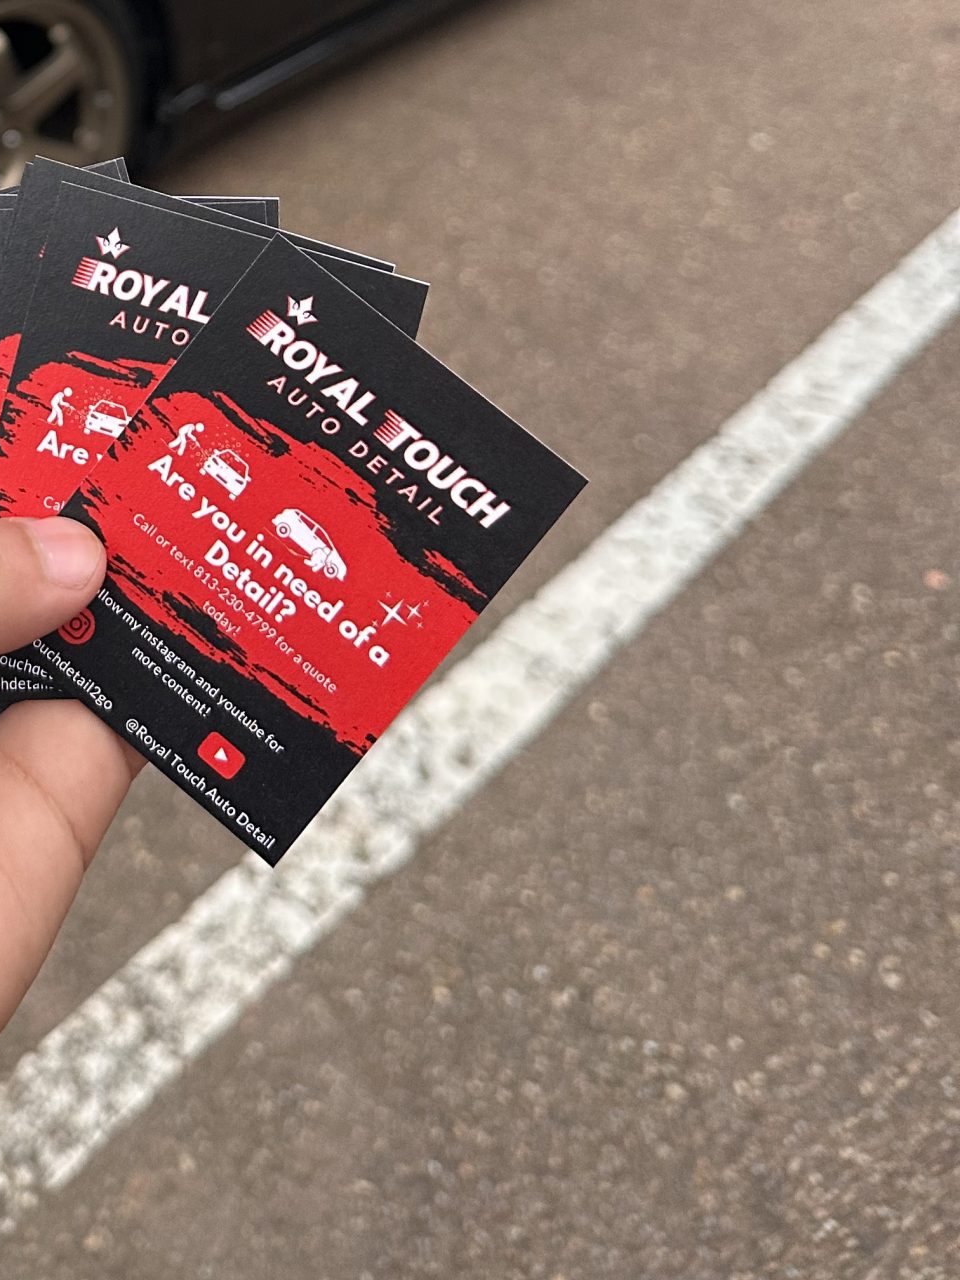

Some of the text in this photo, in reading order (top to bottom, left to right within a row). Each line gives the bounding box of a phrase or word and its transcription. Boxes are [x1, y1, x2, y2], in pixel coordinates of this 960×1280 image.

[77, 257, 212, 324] ROYAL
[109, 310, 190, 347] AUTO
[36, 429, 89, 465] Are
[250, 314, 511, 529] ROYAL TOUCH
[266, 375, 444, 526] AUTO DETAIL
[147, 454, 390, 667] Are you in need of a
[203, 539, 297, 623] Detail?
[133, 513, 338, 694] Call or text 813-230-4799 for a quote
[202, 600, 242, 637] today!
[33, 638, 114, 711] ouchdetail2go
[97, 588, 285, 754] llow my instagram and youtube for
[131, 646, 212, 718] more content!
[125, 718, 276, 850] @Royal Touch Auto Detail
